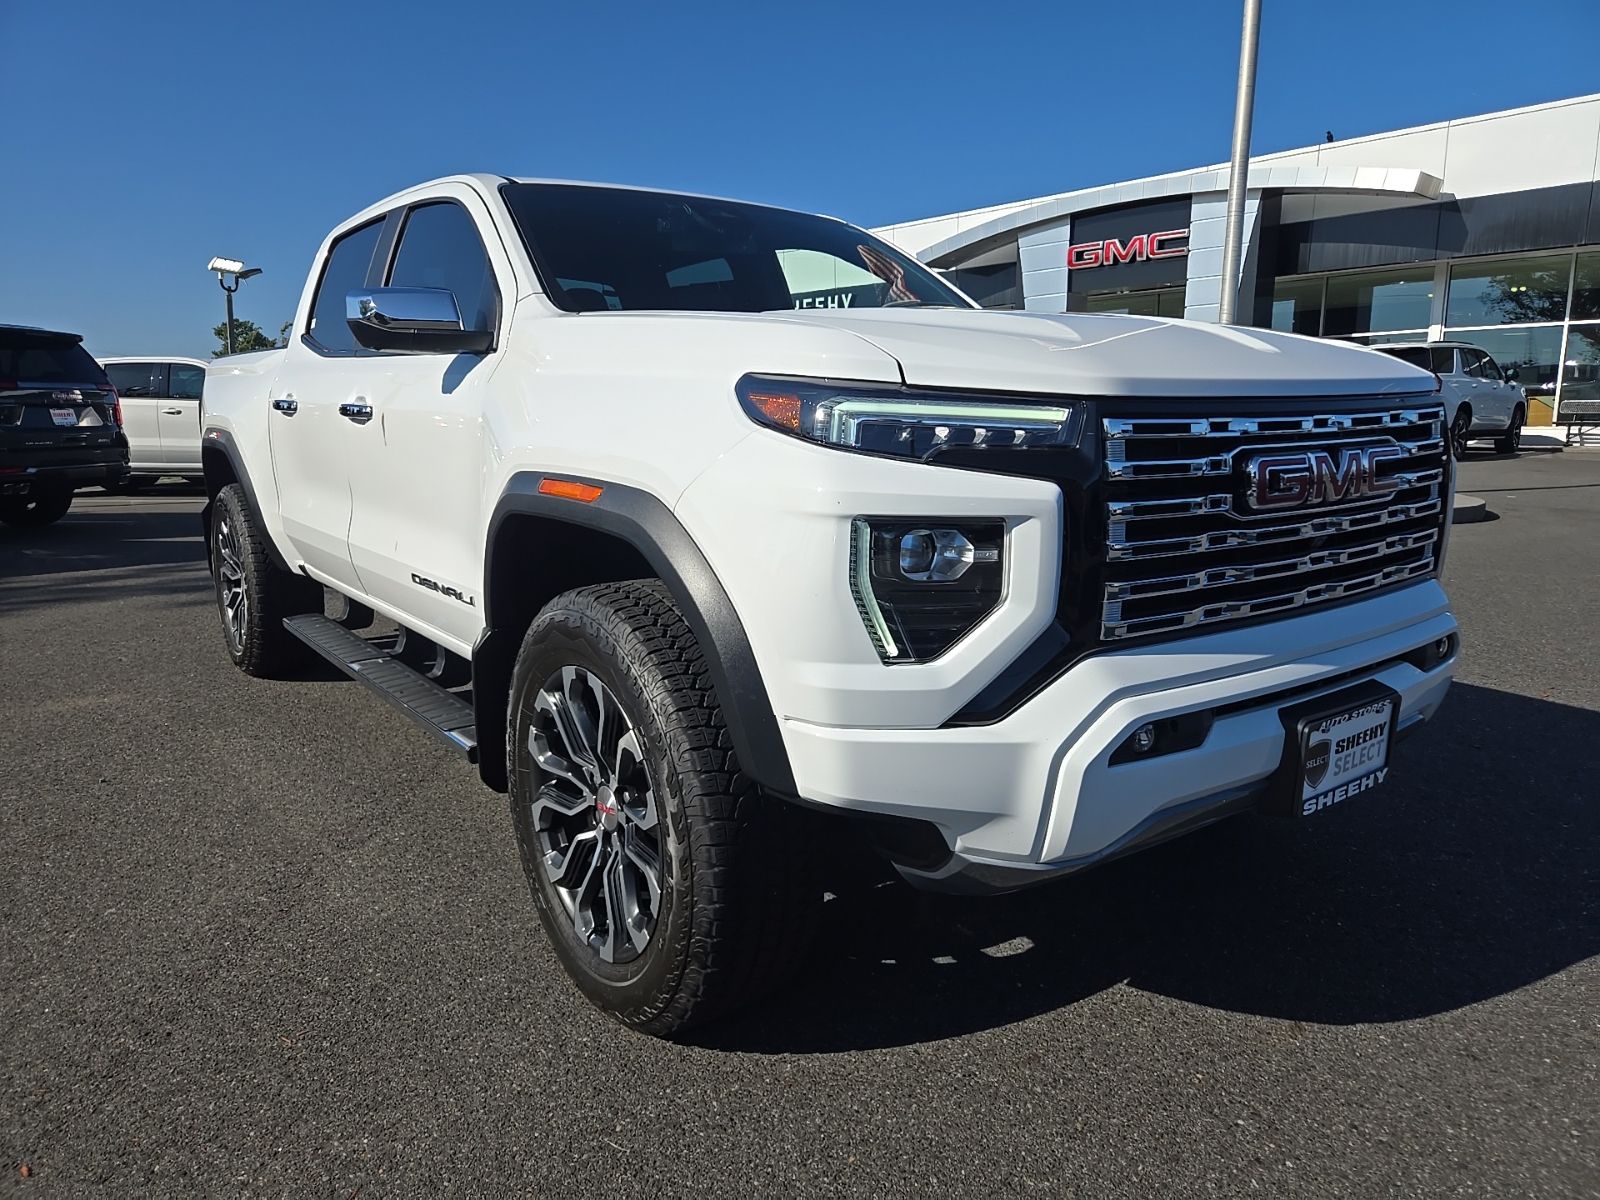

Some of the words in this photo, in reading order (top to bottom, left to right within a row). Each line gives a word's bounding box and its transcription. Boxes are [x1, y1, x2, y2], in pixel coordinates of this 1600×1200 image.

[1067, 228, 1190, 269] GMC
[1248, 446, 1401, 510] GMC
[411, 572, 476, 607] DENALI
[1320, 714, 1349, 731] AUTO
[1335, 721, 1387, 755] SHEEHY
[1305, 754, 1329, 769] SELECT
[1333, 739, 1384, 776] SELECT
[1302, 767, 1389, 816] SHEEHY
